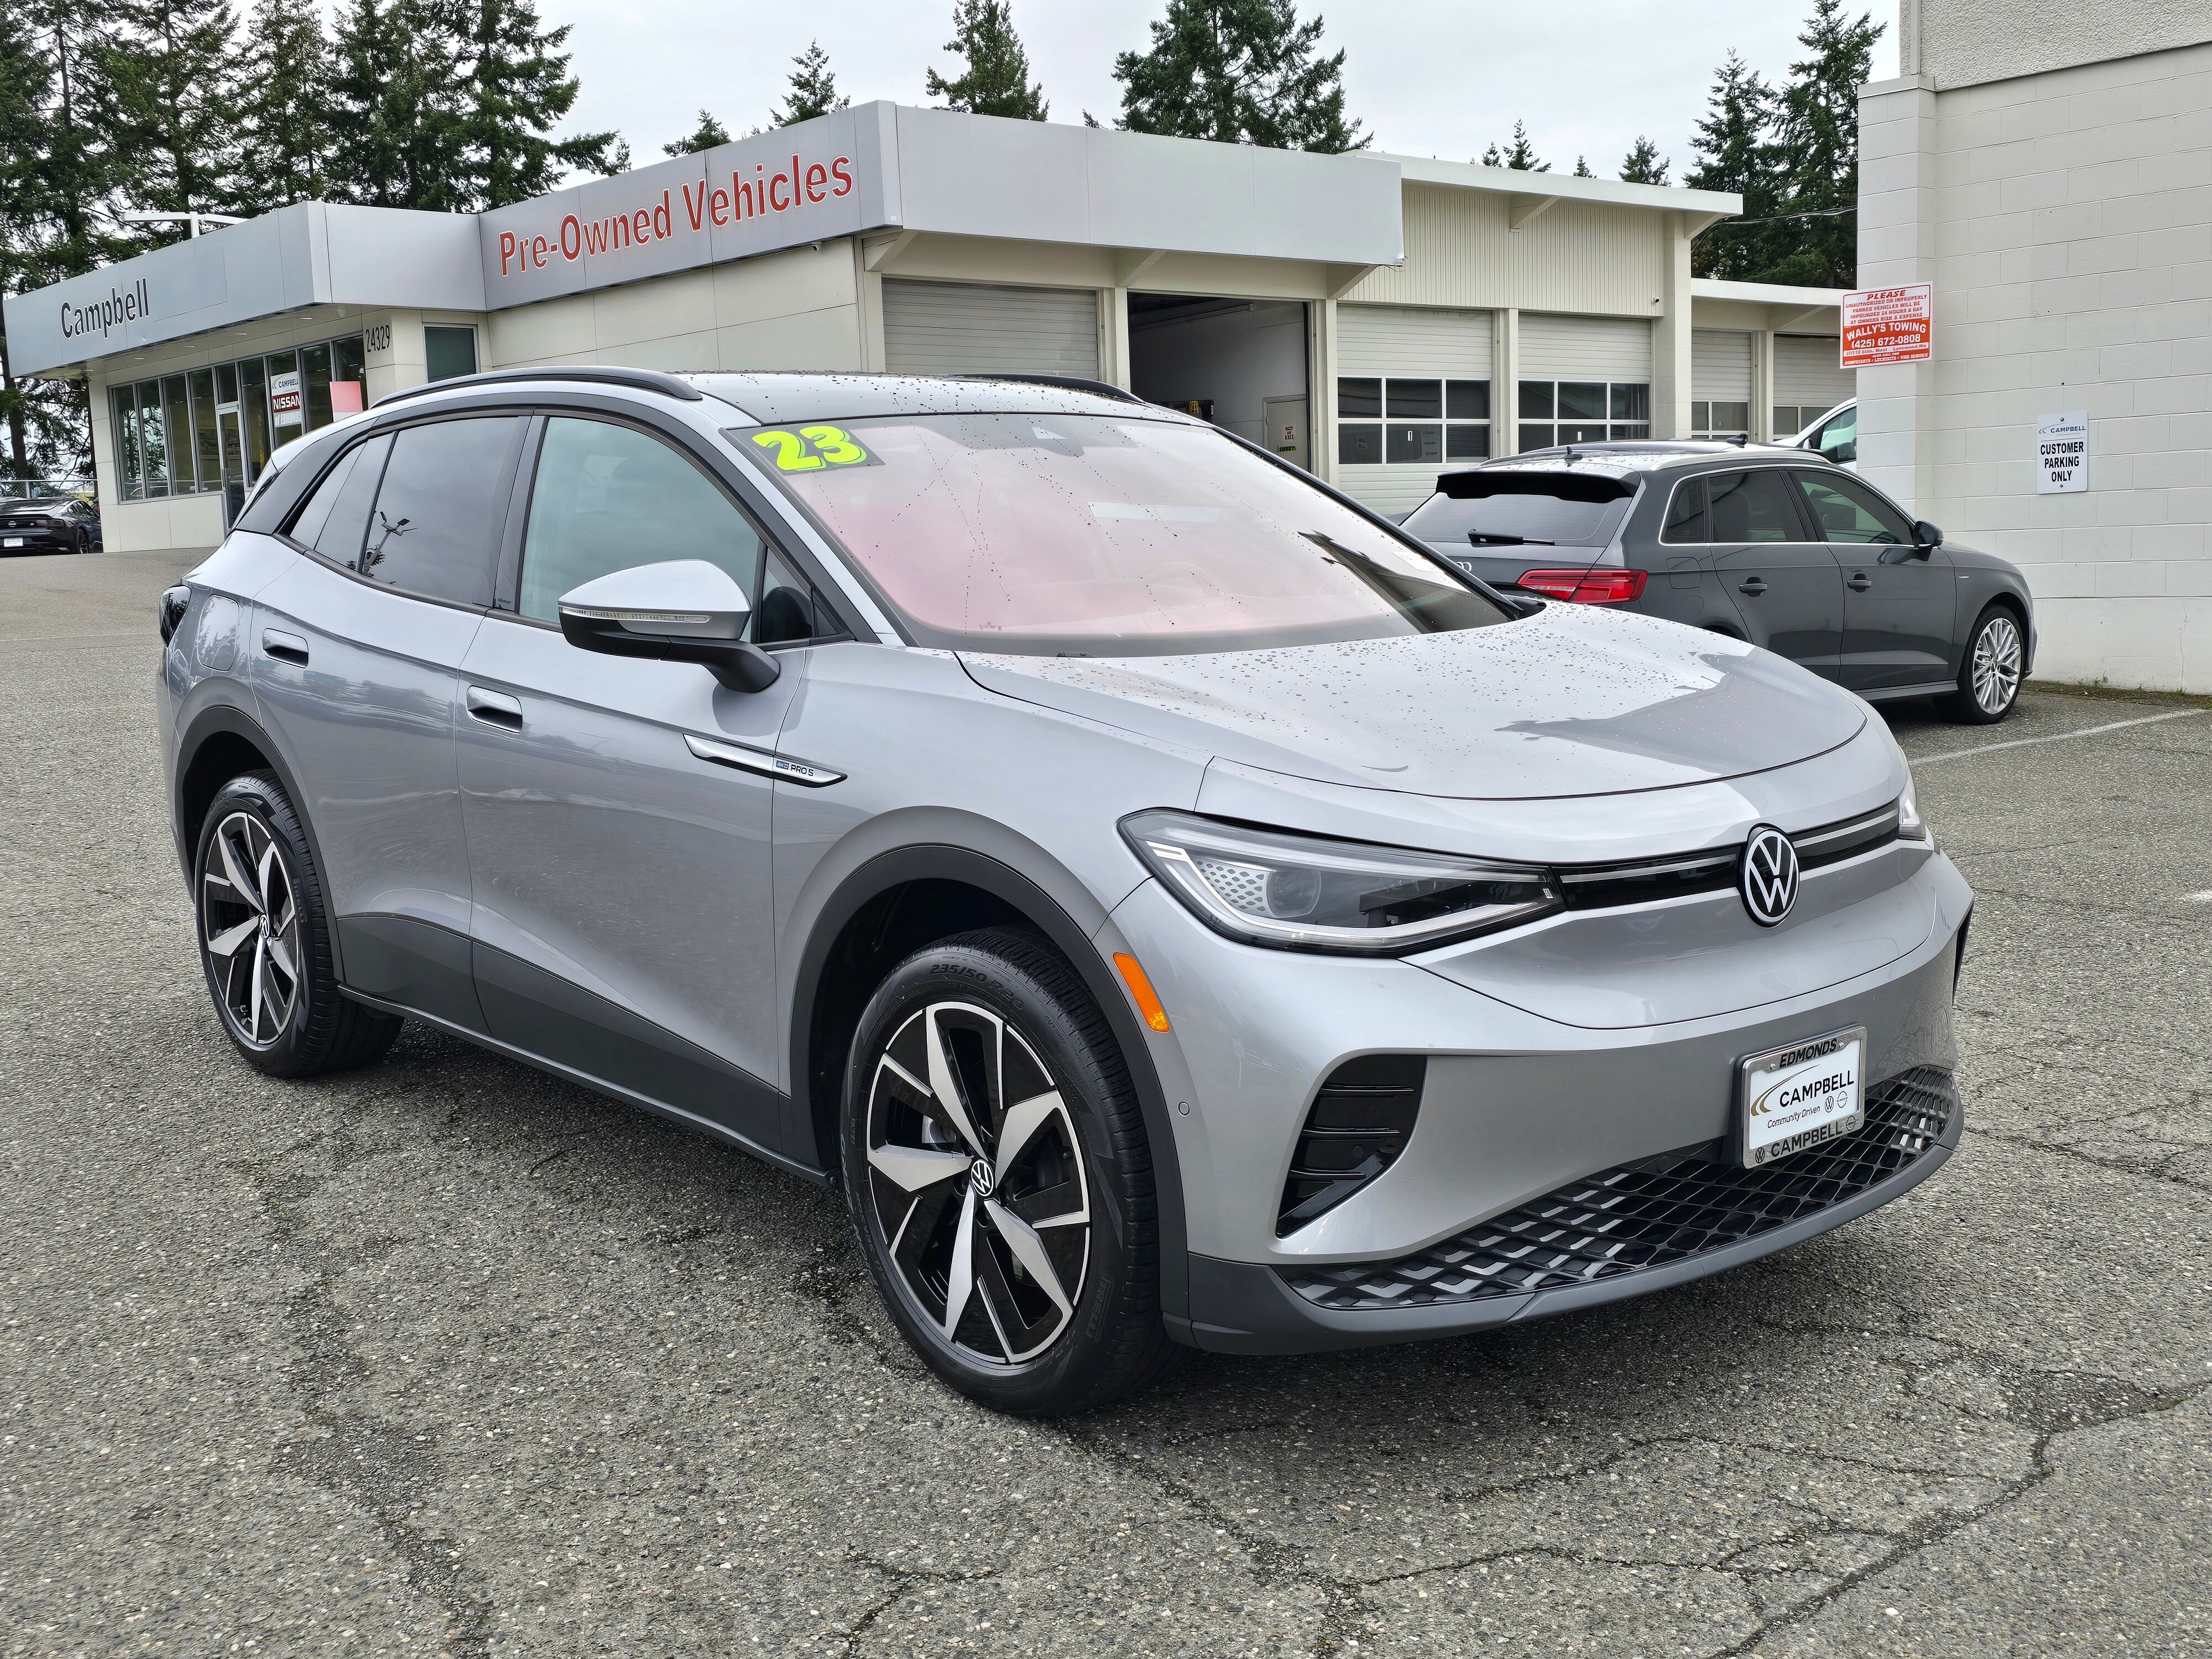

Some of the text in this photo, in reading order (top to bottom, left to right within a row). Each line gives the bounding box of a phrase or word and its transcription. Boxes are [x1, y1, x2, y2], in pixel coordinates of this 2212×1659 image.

[500, 154, 852, 276] Pre-Owned Vehicles
[1867, 290, 1906, 300] PLEASE
[61, 278, 150, 340] Campbell
[366, 325, 390, 352] 24329
[1846, 322, 1927, 341] WALLY'S TOWING
[1851, 333, 1921, 348] (425) 672-0808
[273, 395, 300, 410] NISSAN
[752, 426, 867, 471] 23
[2041, 442, 2084, 455] CUSTOMER
[2044, 456, 2079, 469] PARKING
[2052, 471, 2072, 482] ONLY
[791, 764, 807, 775] PRO
[930, 964, 987, 983] 235/50
[1779, 1038, 1837, 1068] EDMONDS
[1780, 1070, 1854, 1108] CAMPBELL
[1767, 1106, 1820, 1129] Community Driven
[1771, 1121, 1843, 1157] CAMPBELL
